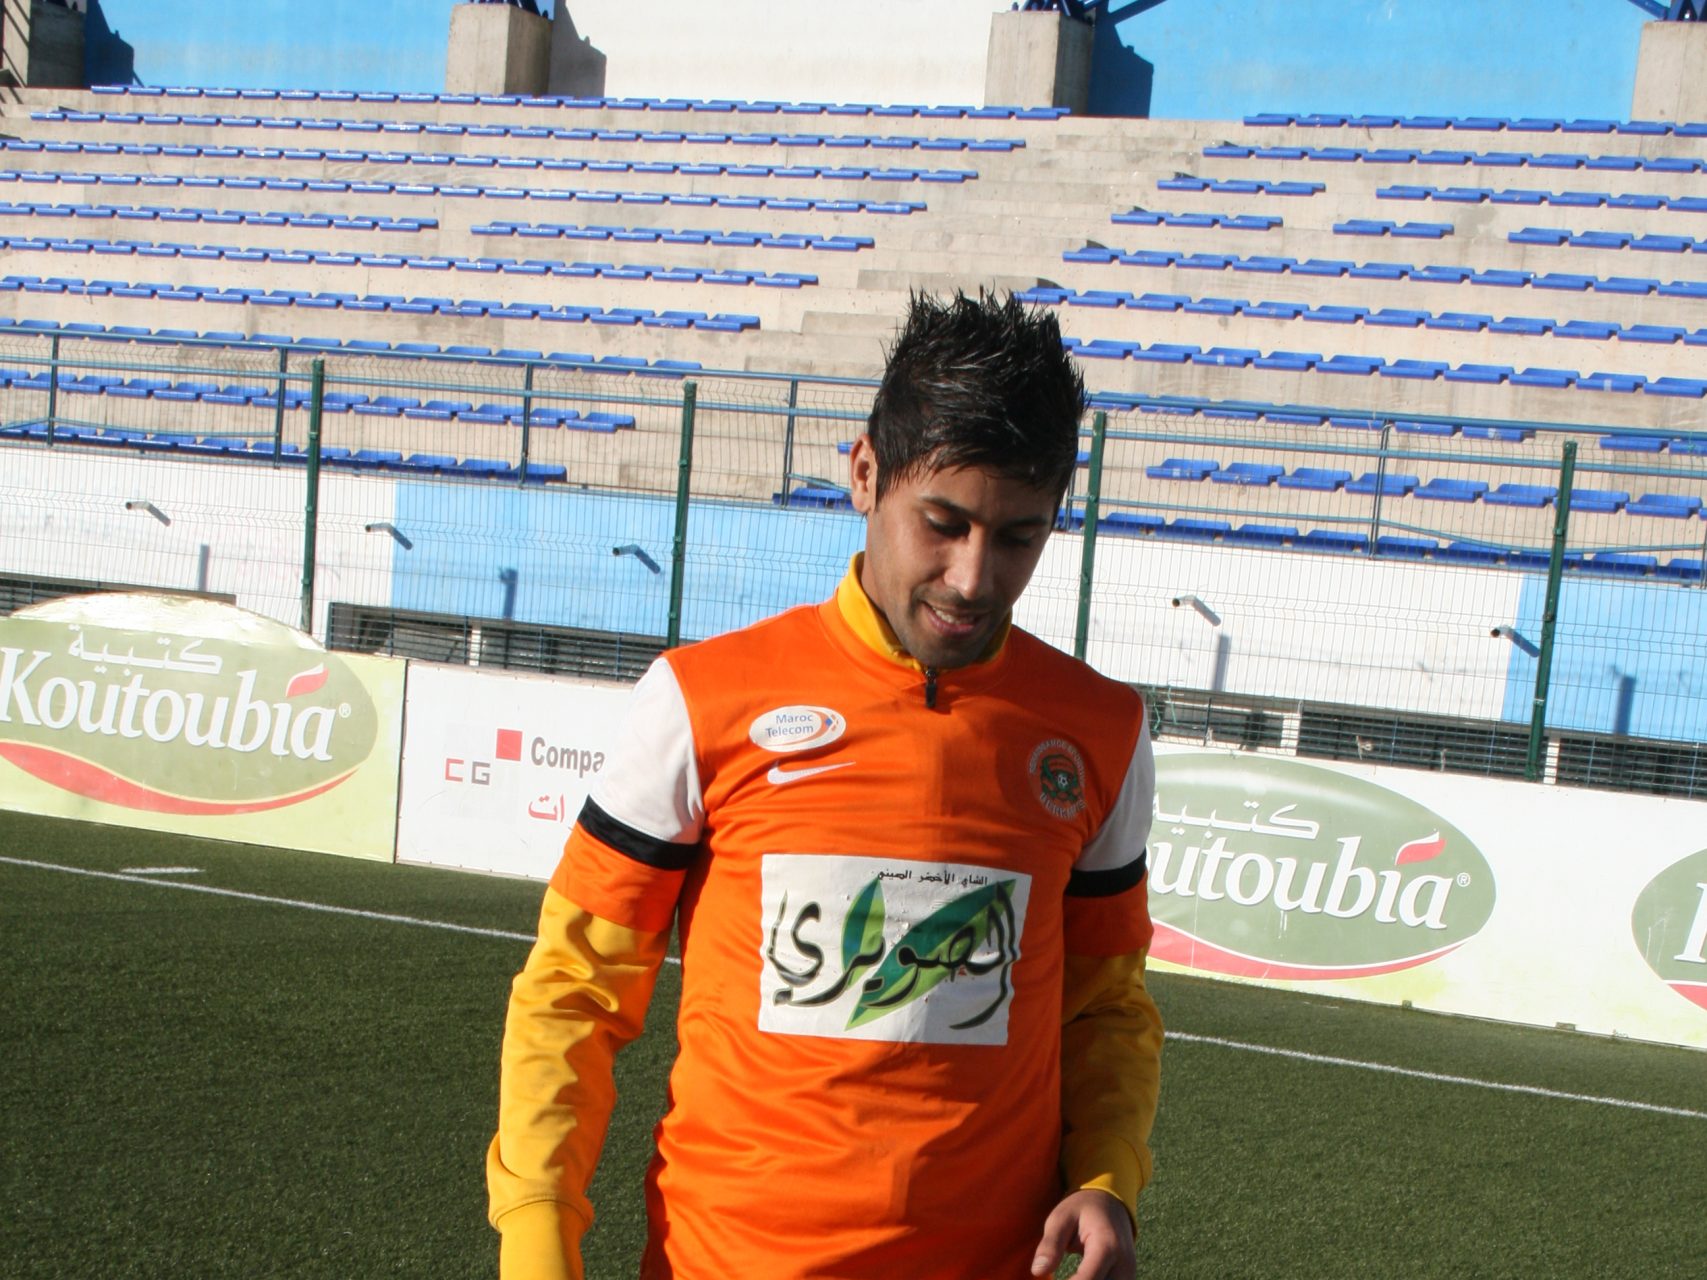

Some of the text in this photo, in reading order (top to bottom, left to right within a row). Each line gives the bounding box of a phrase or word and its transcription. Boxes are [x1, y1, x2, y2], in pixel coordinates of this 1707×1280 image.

[68, 624, 223, 676] كتبية
[765, 725, 814, 738] Telecom
[775, 714, 813, 725] Maroc
[531, 736, 605, 778] Compa
